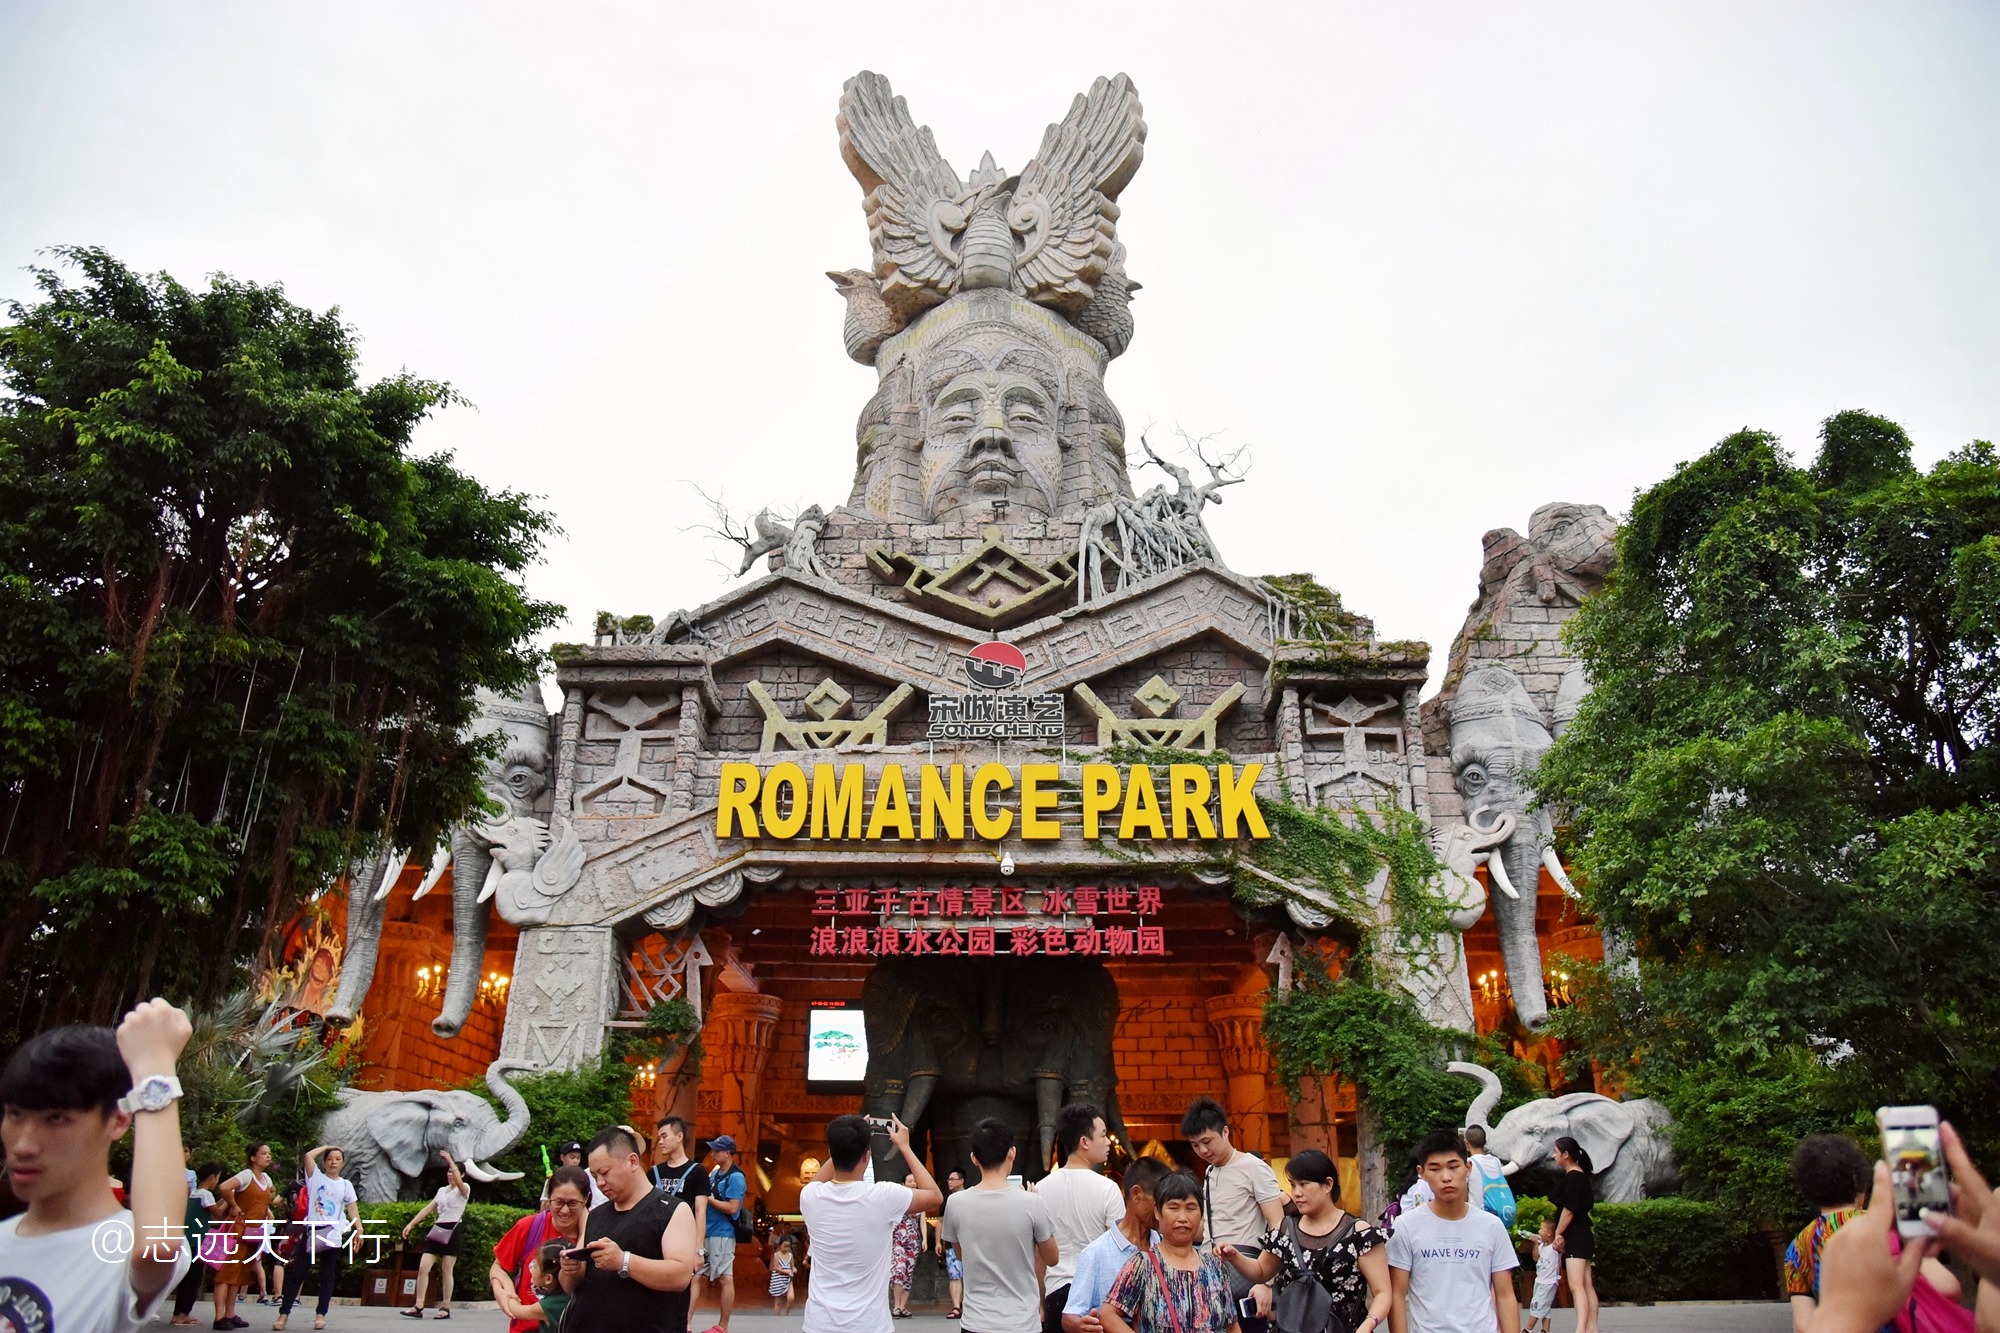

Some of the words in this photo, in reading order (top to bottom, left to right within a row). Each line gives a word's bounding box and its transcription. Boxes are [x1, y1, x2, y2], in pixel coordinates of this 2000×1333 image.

[928, 694, 1064, 722] 宋城演艺
[927, 722, 1064, 738] SONGCHENG
[716, 761, 1061, 840] ROMANCE
[1082, 763, 1271, 840] PARK
[811, 887, 1028, 917] 三亚千古情景区
[1041, 887, 1164, 917] 冰雪世界
[810, 926, 996, 957] 浪浪浪水公园
[1010, 926, 1165, 957] 彩色动物园
[1420, 1248, 1451, 1258] WAVE
